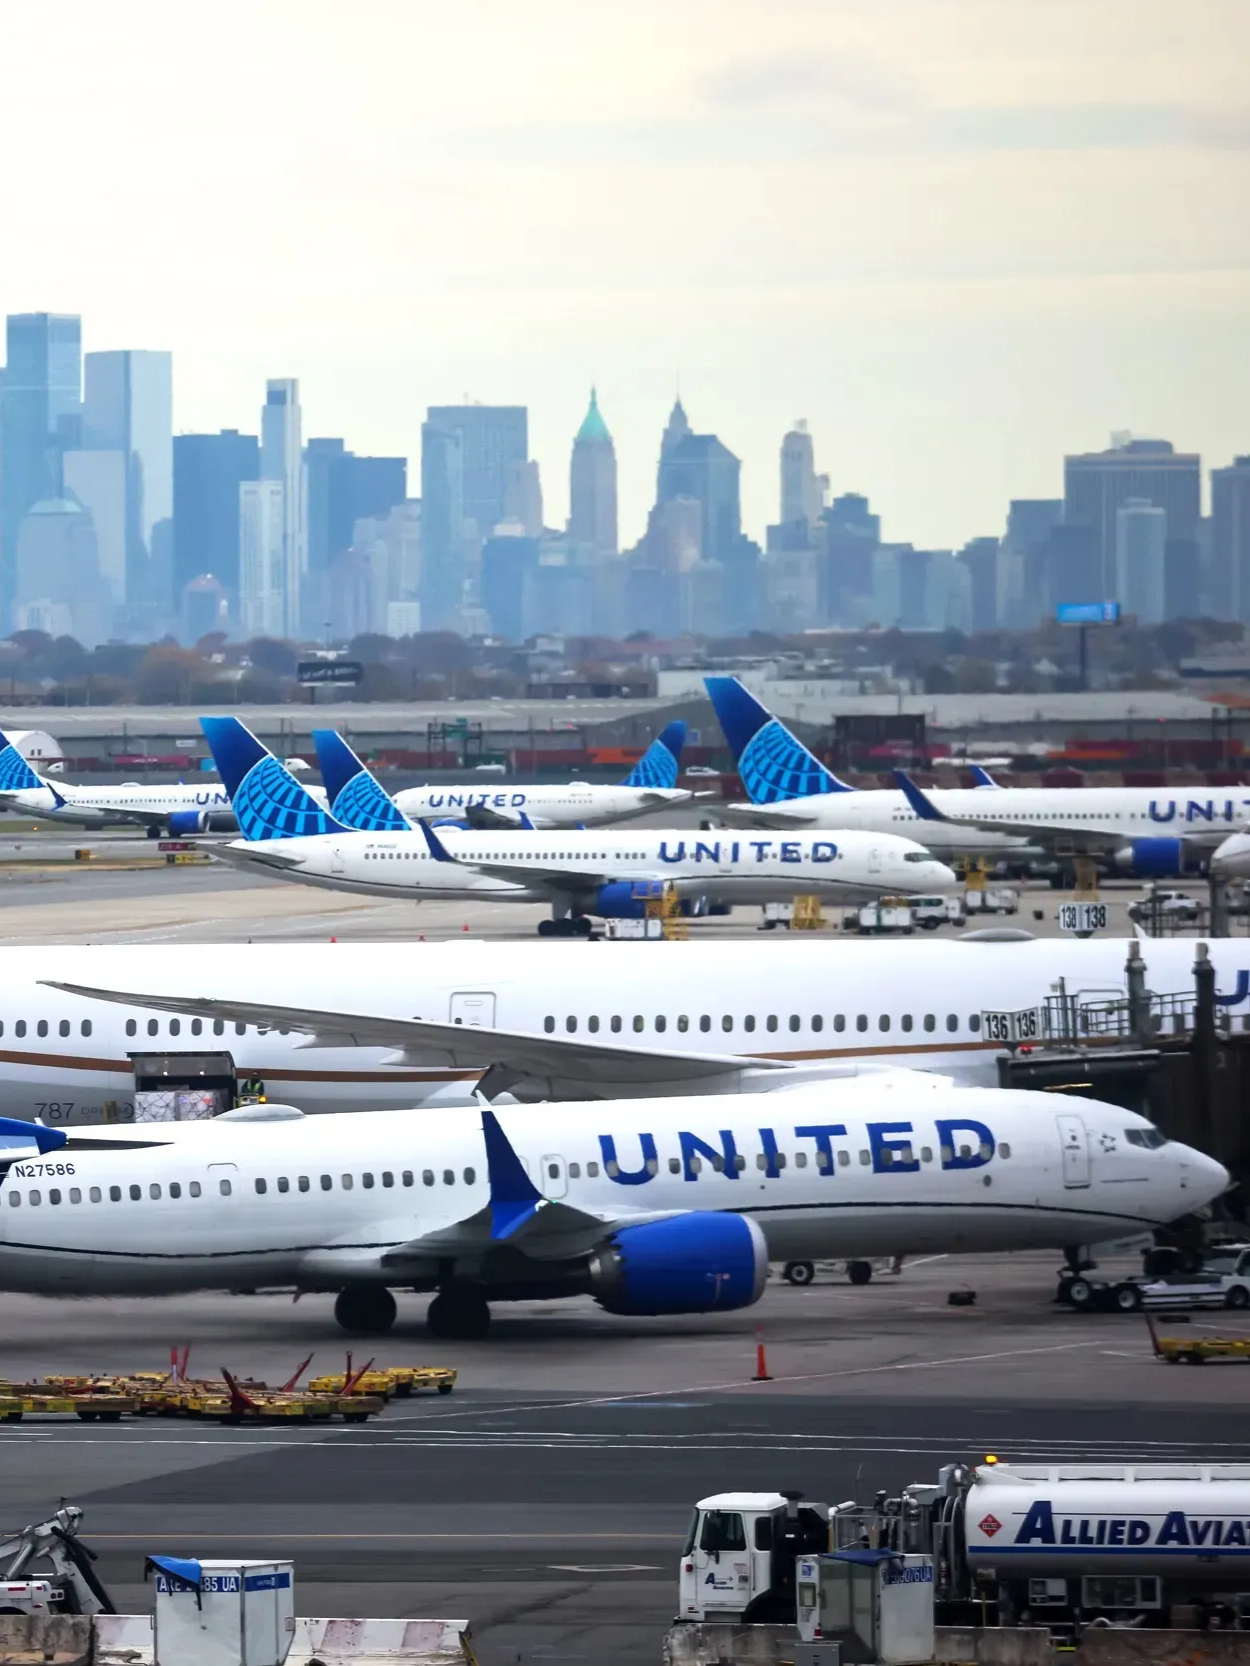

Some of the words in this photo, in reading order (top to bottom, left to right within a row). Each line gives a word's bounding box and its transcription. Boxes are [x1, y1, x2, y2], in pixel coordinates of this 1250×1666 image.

[430, 793, 527, 808] UNITED
[659, 841, 840, 864] UNITED
[1061, 905, 1077, 929] 138
[1085, 904, 1106, 929] 138
[984, 1014, 1008, 1040] 136
[1016, 1011, 1036, 1038] 136
[34, 1102, 75, 1120] 787
[597, 1118, 997, 1186] UNITED
[14, 1162, 76, 1178] N27586
[1013, 1500, 1151, 1546] ALLIED
[222, 1576, 238, 1592] UA
